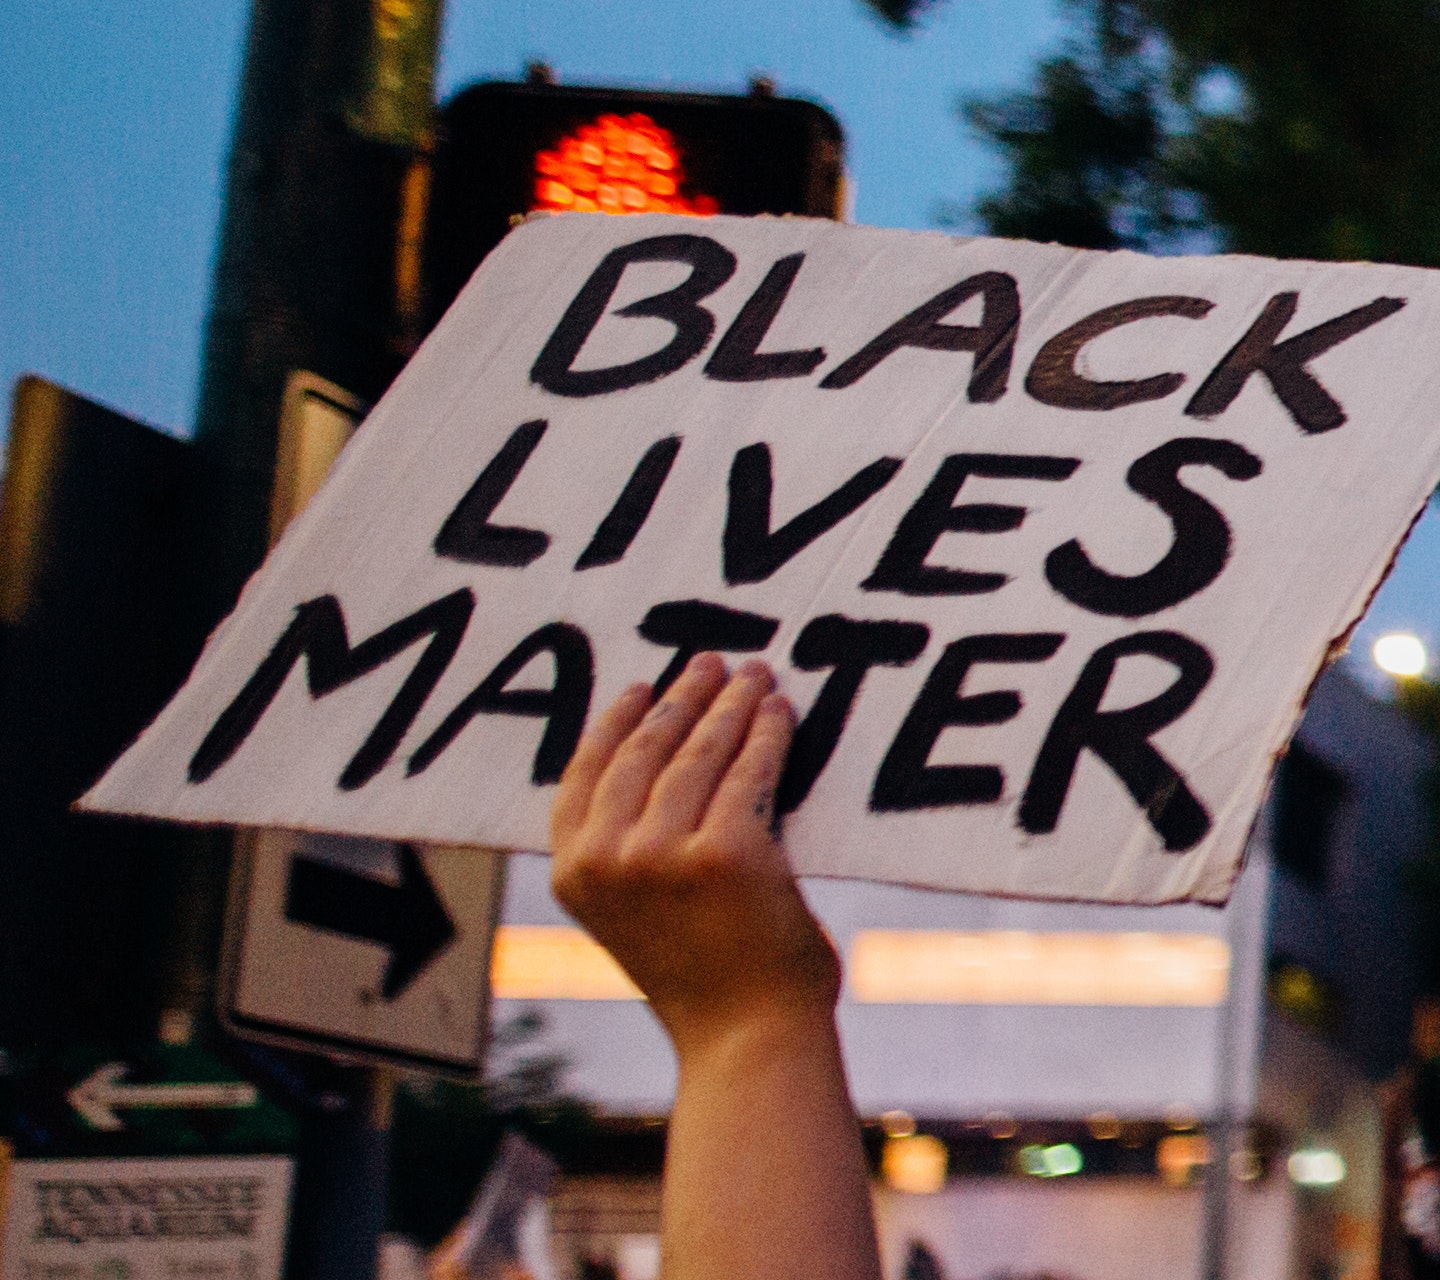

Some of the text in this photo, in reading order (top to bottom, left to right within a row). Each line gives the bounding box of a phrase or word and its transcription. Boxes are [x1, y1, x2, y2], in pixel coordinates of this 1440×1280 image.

[529, 230, 1406, 436] BLACK
[434, 418, 1263, 618] LIVES
[186, 584, 1216, 854] MATTER
